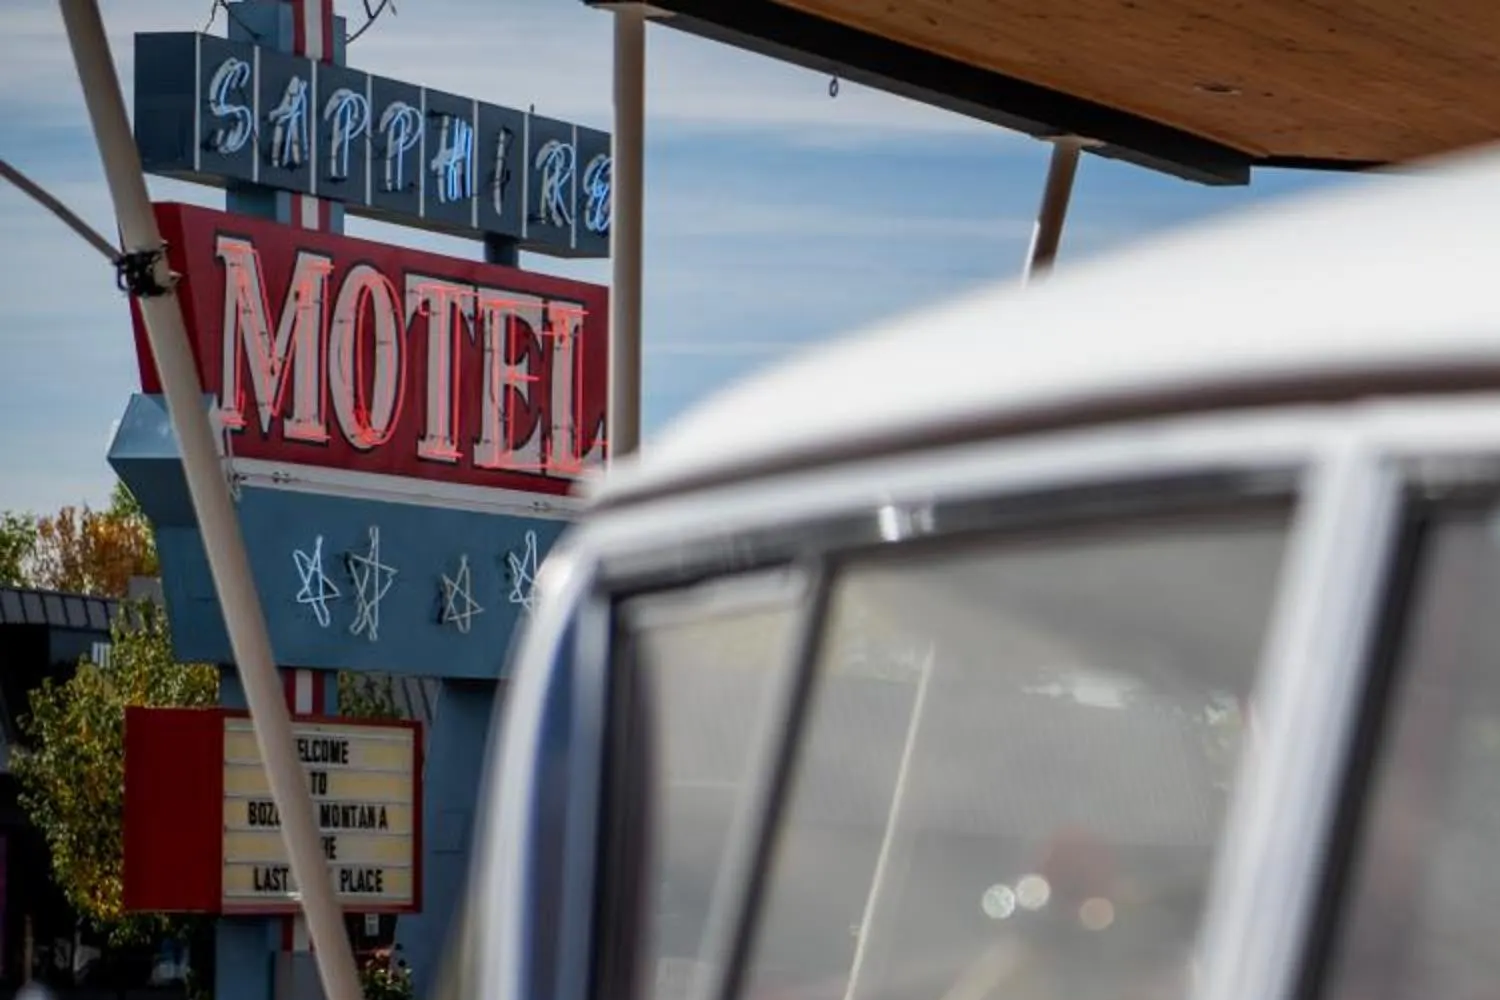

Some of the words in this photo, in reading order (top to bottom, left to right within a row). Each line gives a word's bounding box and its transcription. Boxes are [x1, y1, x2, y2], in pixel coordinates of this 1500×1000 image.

[216, 240, 608, 476] MOTEL
[297, 738, 349, 764] ELCOME
[310, 772, 327, 795] TO
[319, 804, 388, 830] MONTANA
[253, 867, 288, 892] LAST
[339, 869, 384, 893] PLACE
